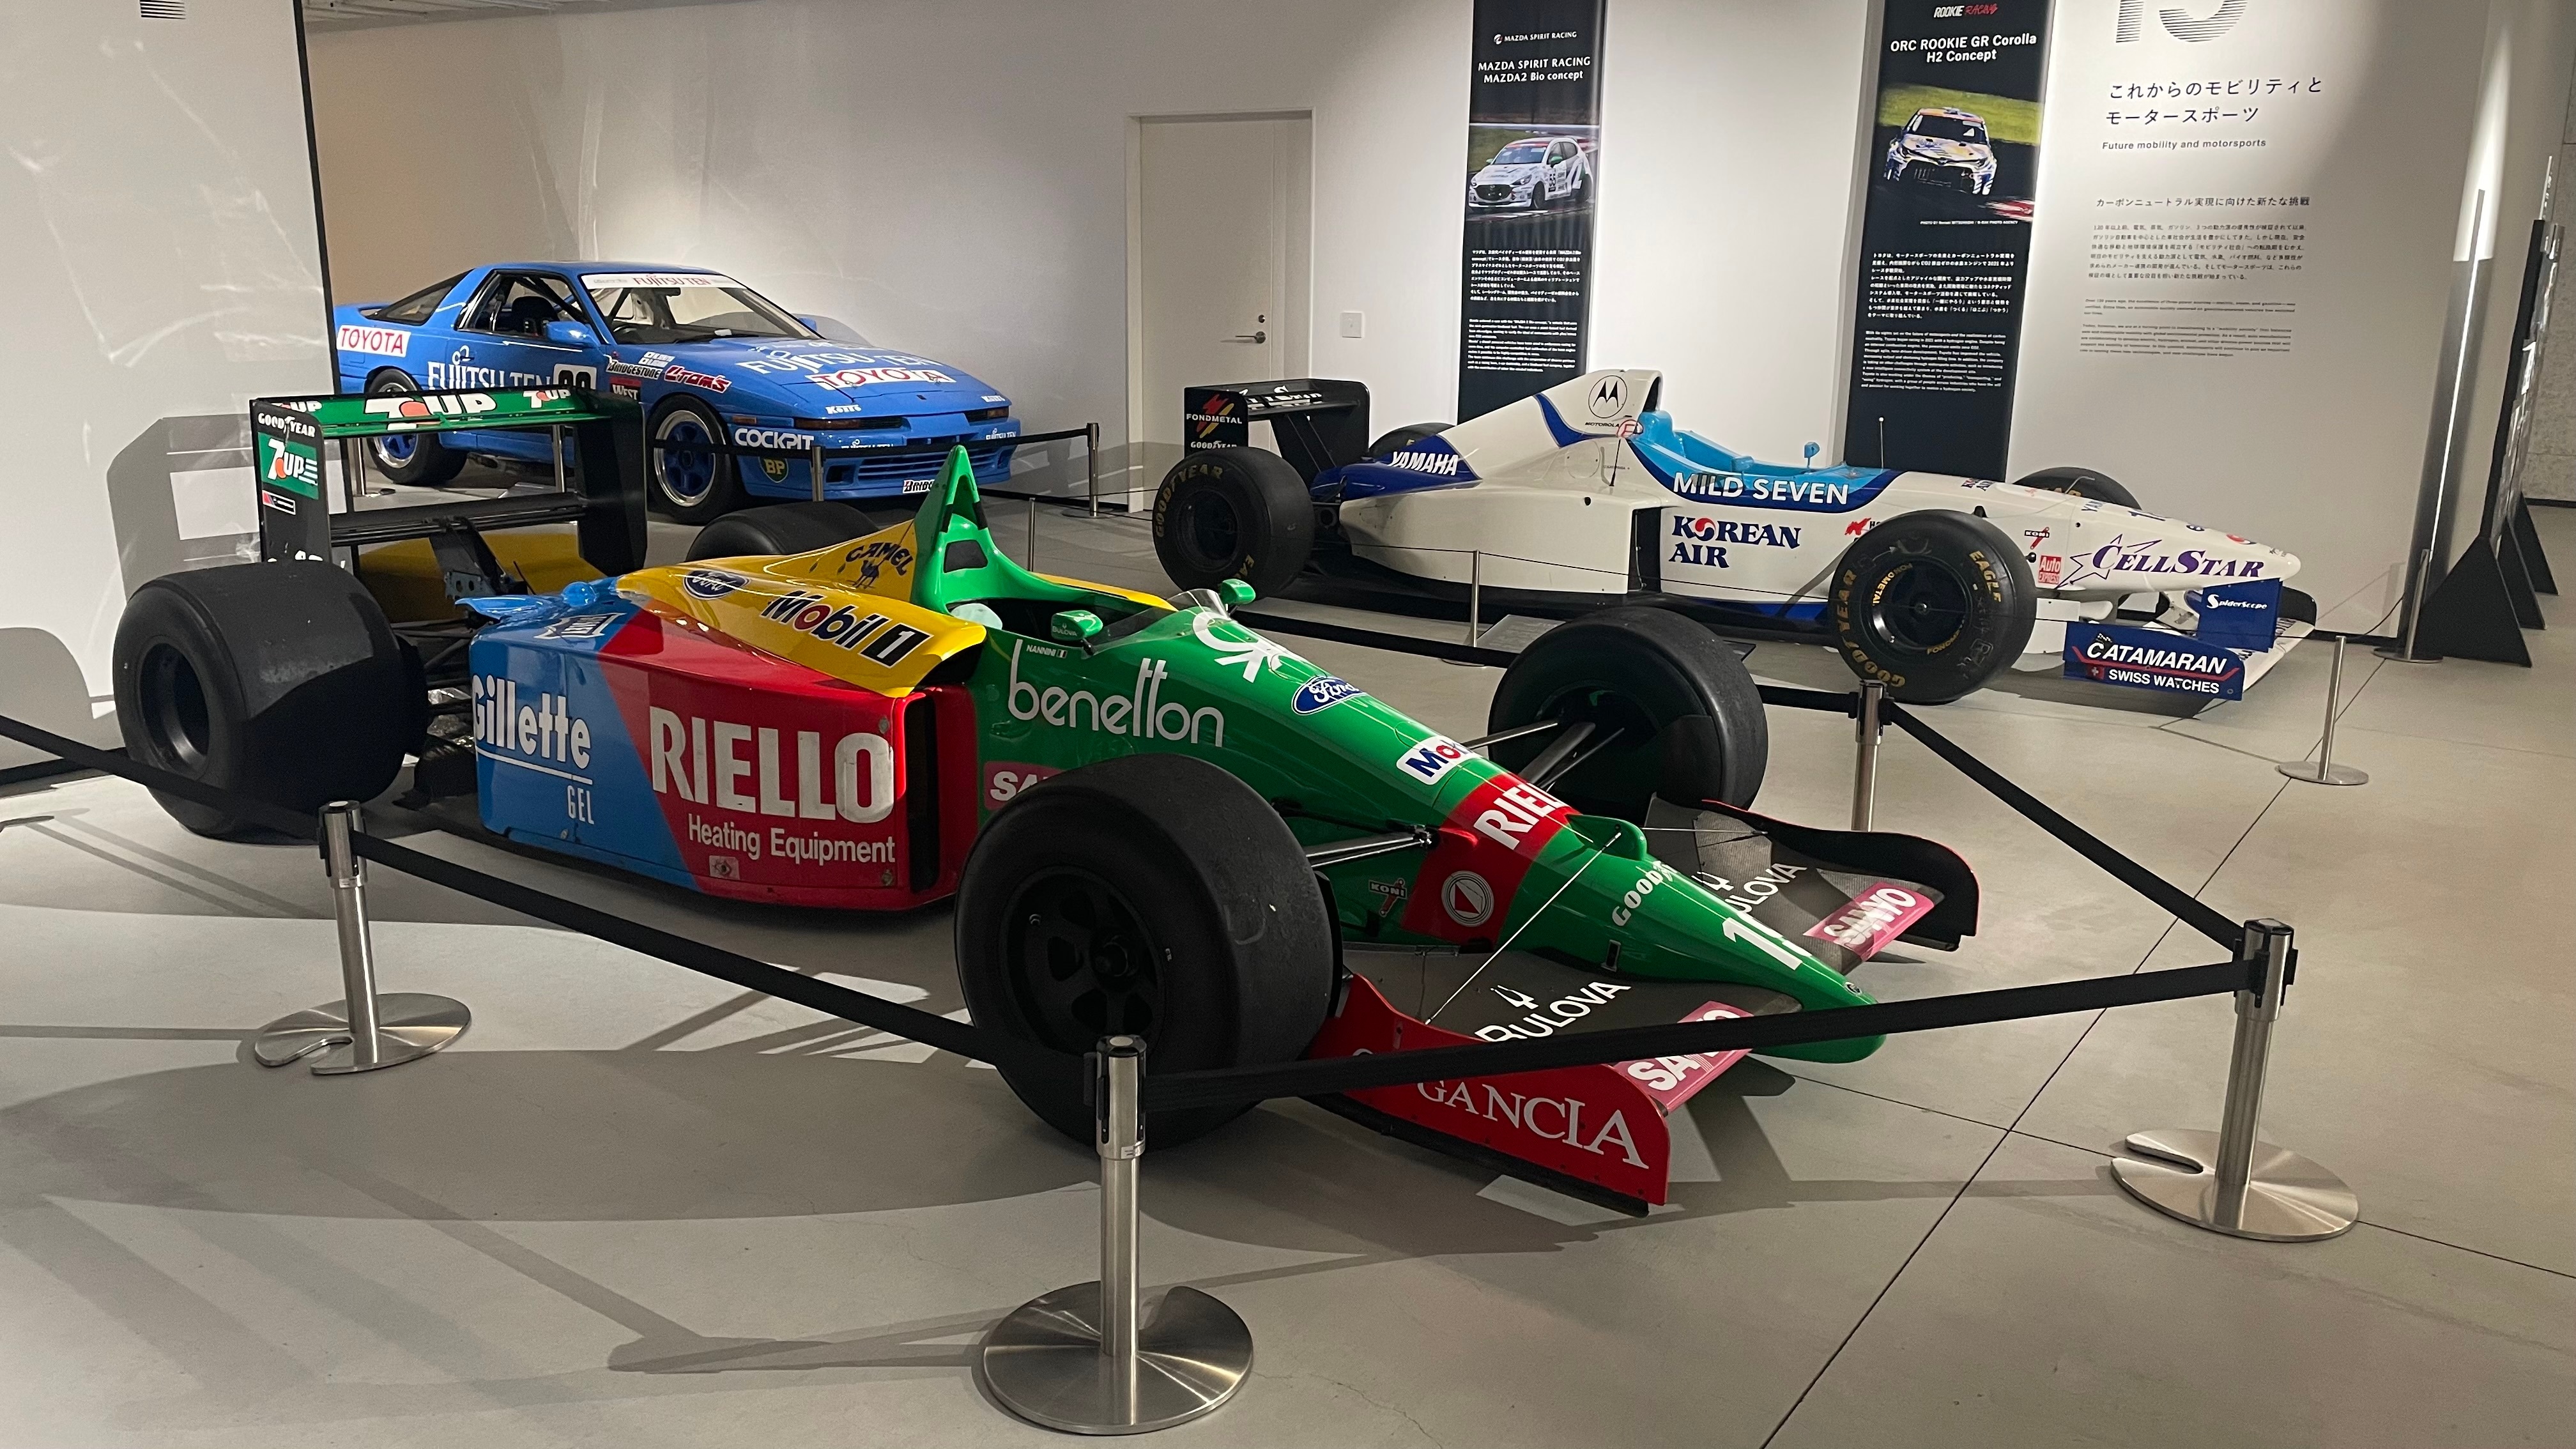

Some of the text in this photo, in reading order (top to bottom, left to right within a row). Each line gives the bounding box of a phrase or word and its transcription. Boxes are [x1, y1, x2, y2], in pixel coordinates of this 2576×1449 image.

[1934, 5, 1965, 18] ROOKIE
[1529, 33, 1550, 41] SPIRIT
[1890, 33, 2037, 51] ORC ROOKIE GR Corolla
[1478, 56, 1591, 72] MAZDA SPIRIT RACING
[1926, 49, 1997, 63] H2 Concept
[1483, 70, 1584, 84] MAZDA2 Bio concept
[2110, 77, 2322, 100] これからのモビリティと
[2106, 105, 2259, 125] モータースポーツ
[2102, 138, 2267, 150] Future mobility and motorsports
[632, 276, 685, 286] FUJITSU
[340, 328, 404, 356] TOYOTA
[427, 355, 505, 390] FUJITSU
[607, 361, 661, 379] BRIDGESTONE
[735, 352, 875, 374] FUJITSU
[811, 367, 947, 388] TOYOTA
[257, 413, 316, 438] GOODYEAR
[1186, 413, 1243, 425] FONDMETAL
[734, 428, 815, 450] COCKPIT
[267, 438, 305, 480] 7UP
[763, 457, 786, 475] BP
[1386, 450, 1459, 476] YAMAHA
[1673, 471, 1849, 505] MILD SEVEN
[1671, 515, 1802, 549] KOREAN
[845, 541, 915, 577] CAMEL
[1668, 542, 1730, 569] AIR
[2039, 556, 2061, 573] Auto
[1968, 549, 2003, 604] EAGLE
[761, 589, 891, 650] Mobil
[1052, 625, 1078, 636] BULOVA
[2086, 642, 2228, 675] CATAMARAN
[1008, 639, 1224, 748] benetton
[1308, 675, 1361, 703] Ford
[2108, 668, 2220, 694] SWISS WATCHES
[471, 673, 592, 770] Gillette
[649, 705, 894, 824] RIELLO
[567, 784, 595, 825] GEL
[688, 813, 895, 867] Heating Equipment
[1370, 882, 1406, 897] KONI
[1473, 980, 1632, 1043] BULOVA
[1416, 1080, 1650, 1170] GANCIA
